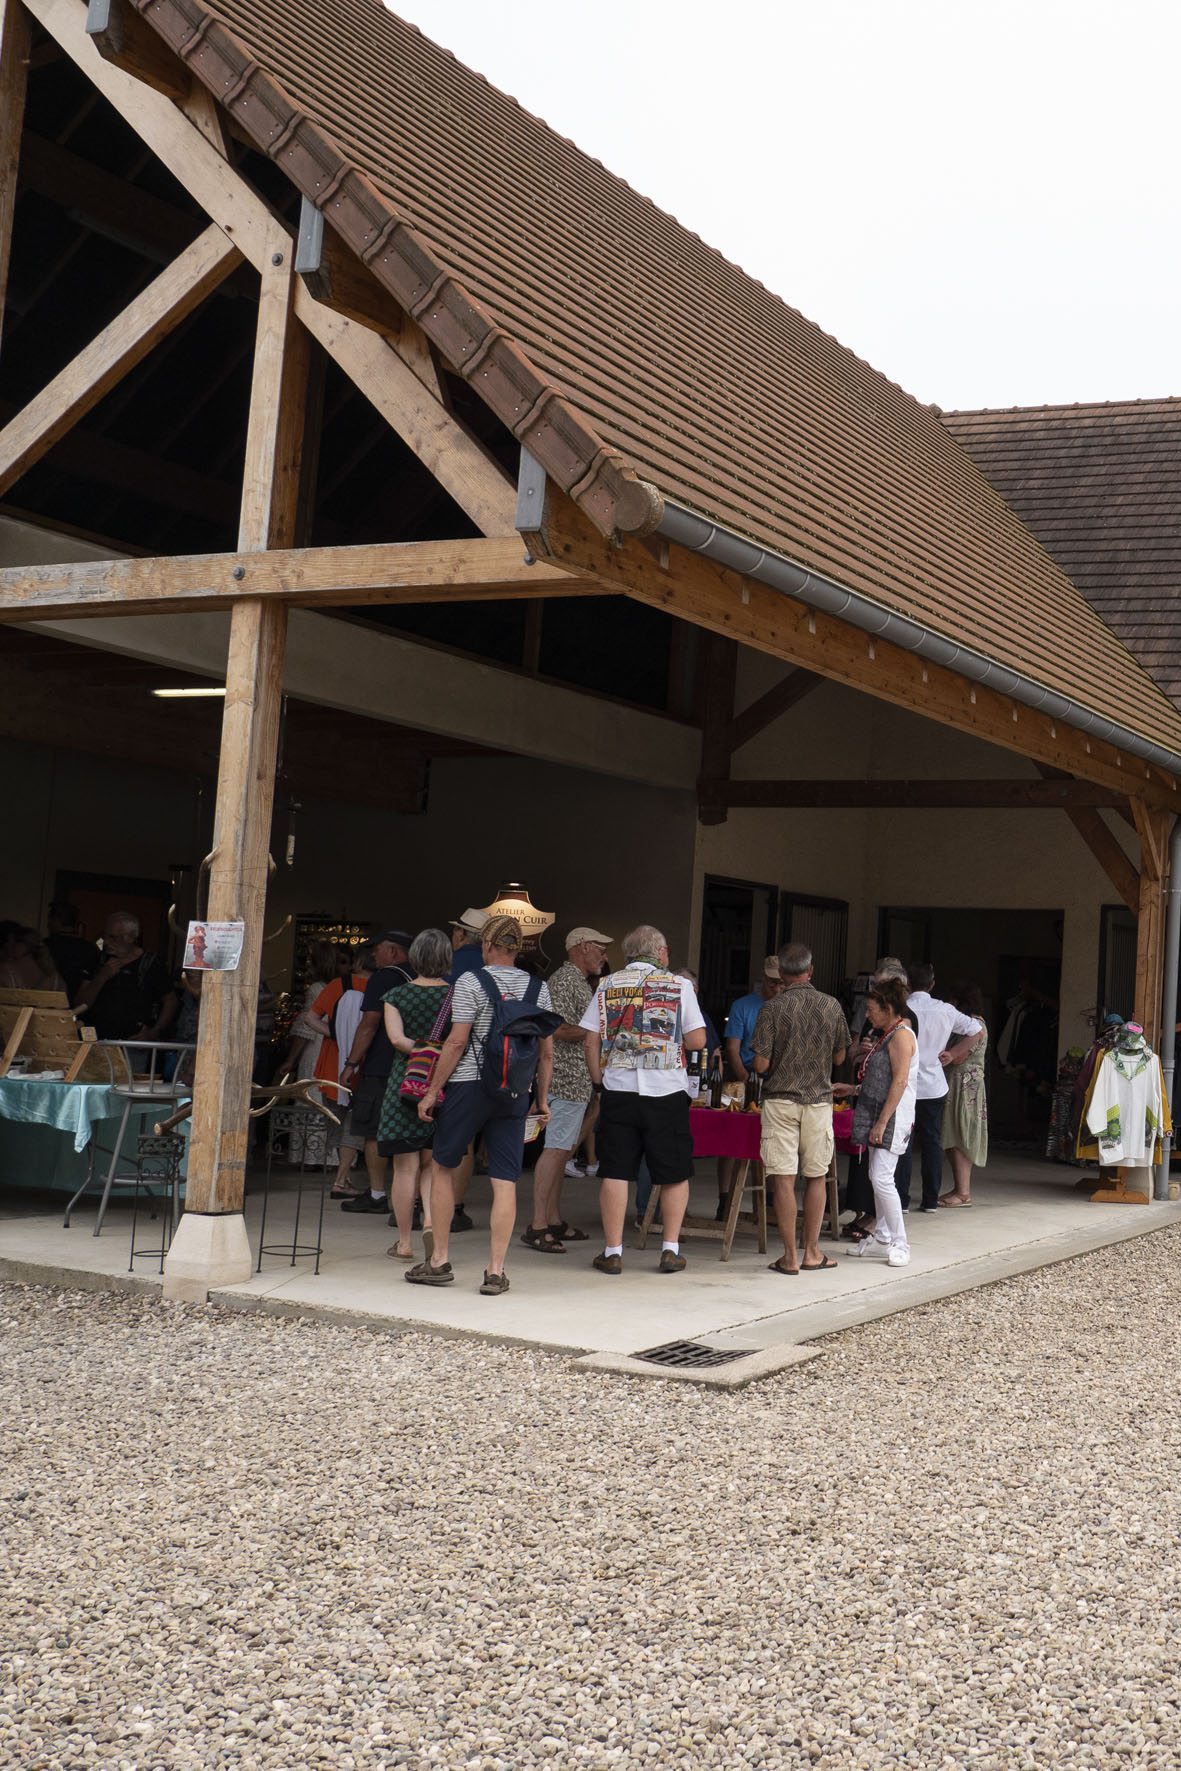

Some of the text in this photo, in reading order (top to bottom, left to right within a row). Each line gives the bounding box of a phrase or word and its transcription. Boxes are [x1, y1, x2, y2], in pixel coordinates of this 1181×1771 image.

[523, 916, 548, 925] CUIR
[607, 988, 623, 998] NEW
[624, 987, 643, 997] YORK
